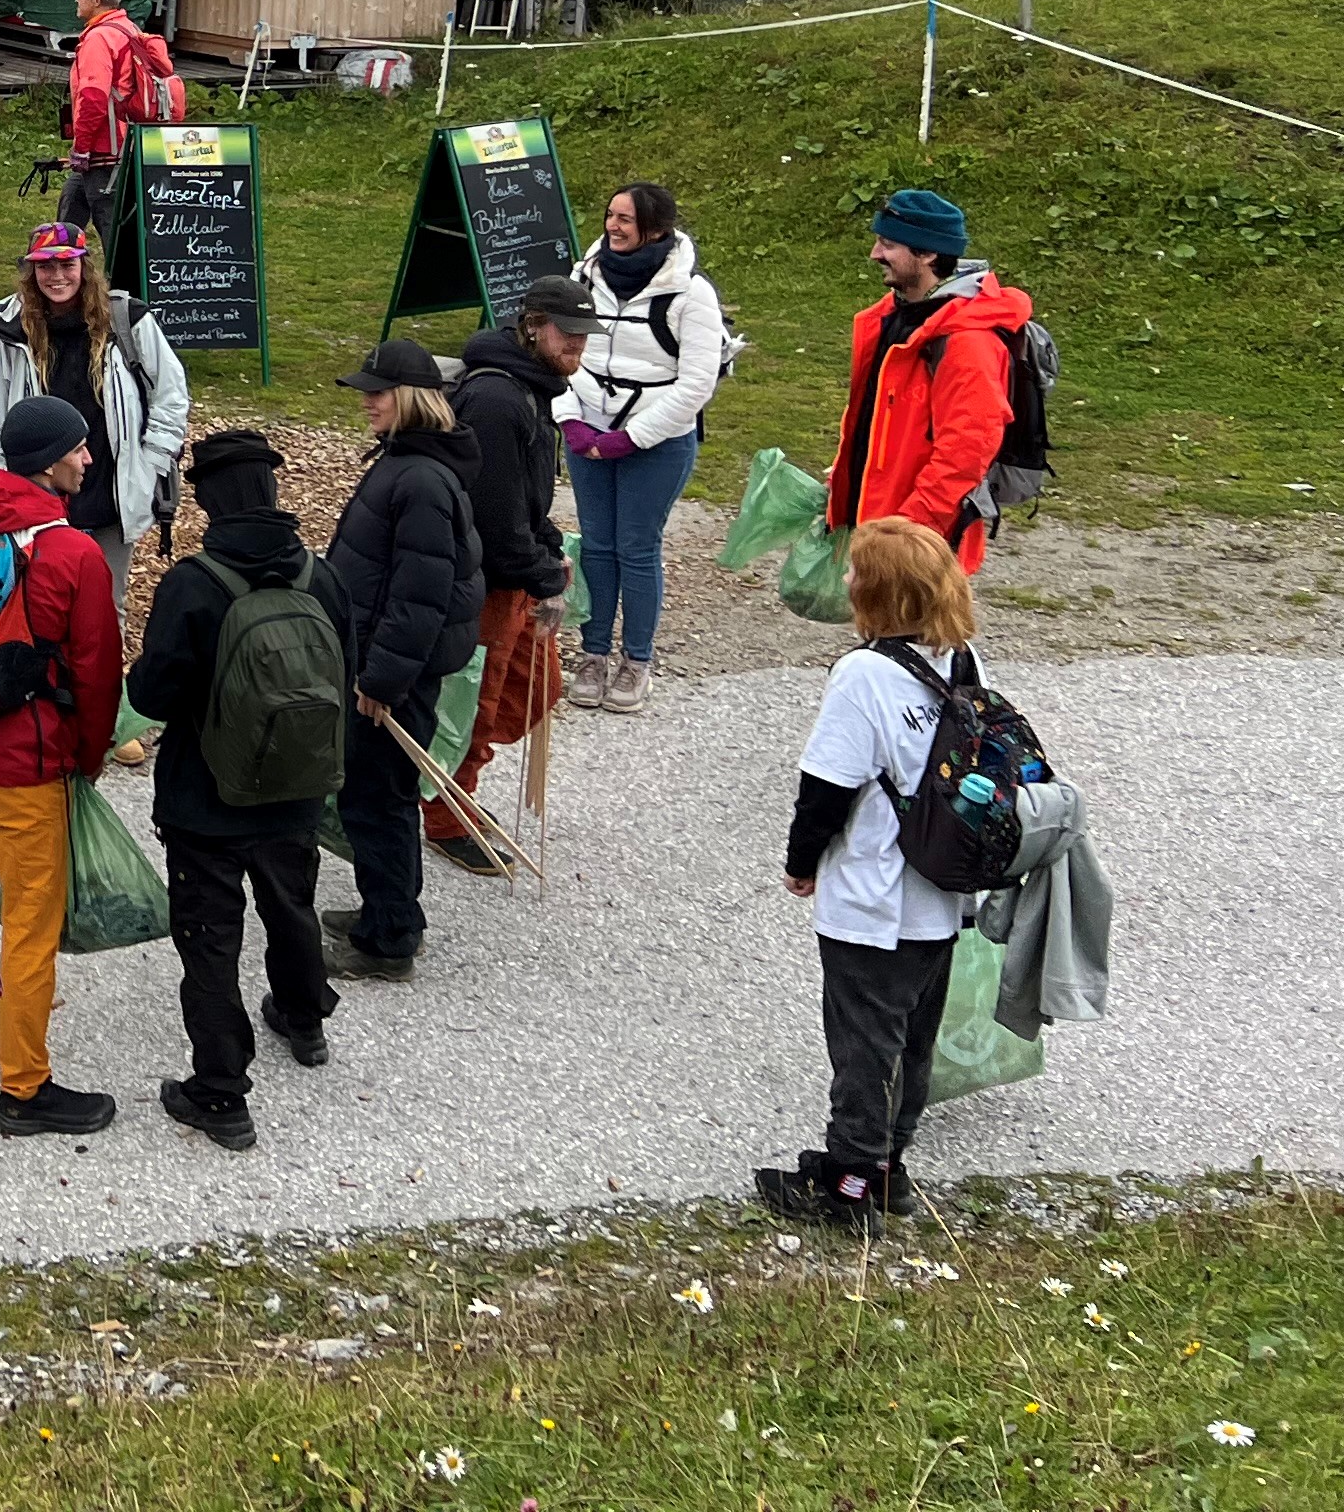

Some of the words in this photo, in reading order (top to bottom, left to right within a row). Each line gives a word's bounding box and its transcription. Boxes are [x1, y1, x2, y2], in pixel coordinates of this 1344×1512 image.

[147, 182, 199, 203] Unser
[186, 179, 245, 210] Tipp!
[151, 213, 230, 235] Zillertaler
[186, 236, 234, 258] Krapfen
[149, 264, 247, 284] Schlutzkrapfen
[223, 309, 240, 320] mit
